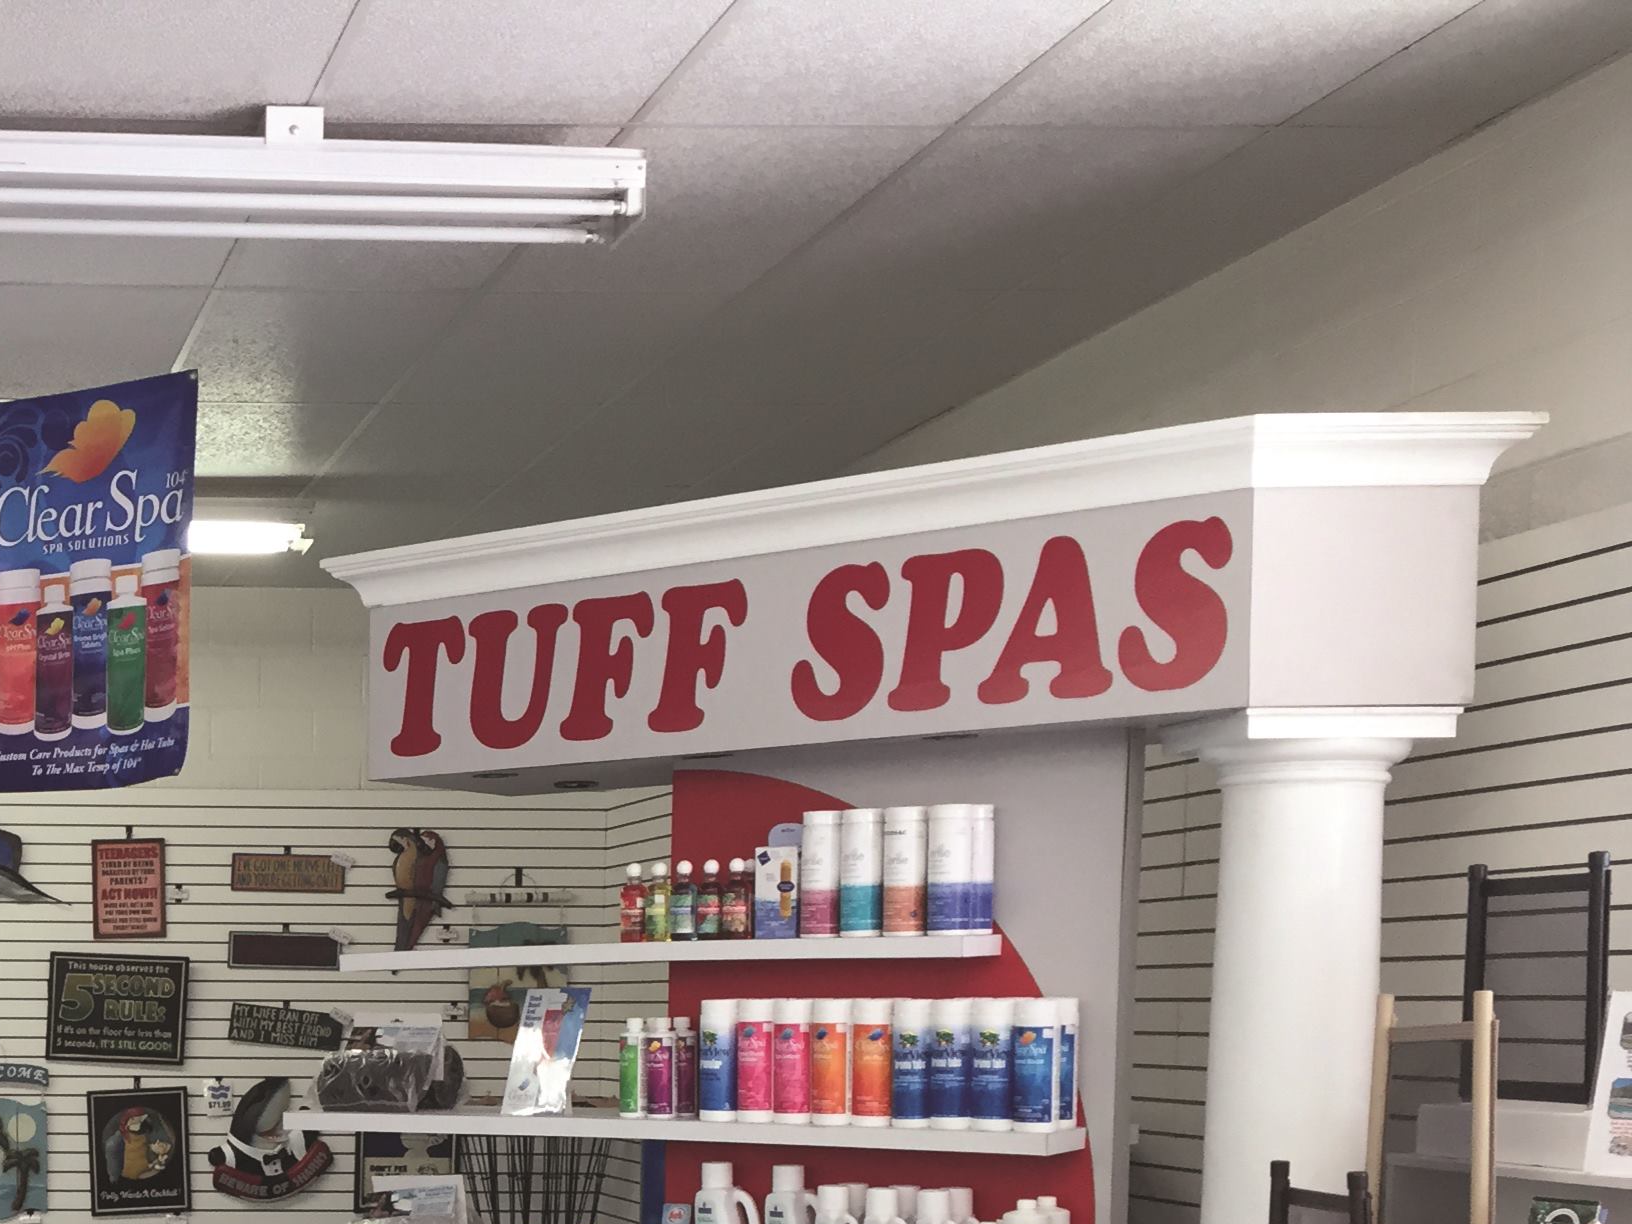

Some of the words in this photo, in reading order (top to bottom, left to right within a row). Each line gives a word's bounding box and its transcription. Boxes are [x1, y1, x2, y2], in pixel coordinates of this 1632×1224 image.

[42, 544, 63, 555] SPA
[68, 534, 129, 551] SOLUTIONS
[382, 578, 748, 757] TUFF
[790, 514, 1234, 722] SPAS
[29, 748, 50, 760] Care
[53, 745, 92, 759] Products
[93, 744, 108, 757] for
[109, 742, 129, 756] Spas
[130, 741, 140, 751] &
[141, 739, 156, 751] Hot
[157, 737, 175, 749] Tubs
[32, 765, 44, 776] To
[45, 764, 61, 775] The
[63, 762, 84, 774] Max
[87, 761, 110, 775] Temp
[112, 758, 122, 774] of
[98, 846, 159, 860] TEENAGERS
[110, 877, 148, 885] PARENTS?
[101, 888, 122, 900] ACT
[68, 961, 86, 970] This
[88, 962, 113, 971] house
[116, 964, 153, 973] observes
[156, 965, 170, 974] the
[58, 973, 95, 1021] 5
[92, 973, 176, 998] SECOND
[234, 1004, 251, 1016] MY
[253, 1006, 276, 1020] WIFE
[279, 1010, 299, 1022] RAN
[302, 1013, 320, 1024] OFF
[88, 1026, 101, 1035] the
[103, 1027, 123, 1037] floor
[124, 1027, 135, 1037] for
[137, 1028, 152, 1038] less
[154, 1029, 172, 1038] than
[233, 1017, 257, 1028] WITH
[259, 1019, 273, 1031] MY
[276, 1021, 301, 1034] BEST
[301, 1023, 332, 1037] FRIEND
[100, 1040, 115, 1049] IT'S
[118, 1040, 137, 1050] STILL
[230, 1029, 254, 1040] AND
[271, 1032, 296, 1045] MISS
[298, 1036, 319, 1047] HIM
[219, 1173, 268, 1197] BEWARE
[272, 1180, 289, 1195] OF
